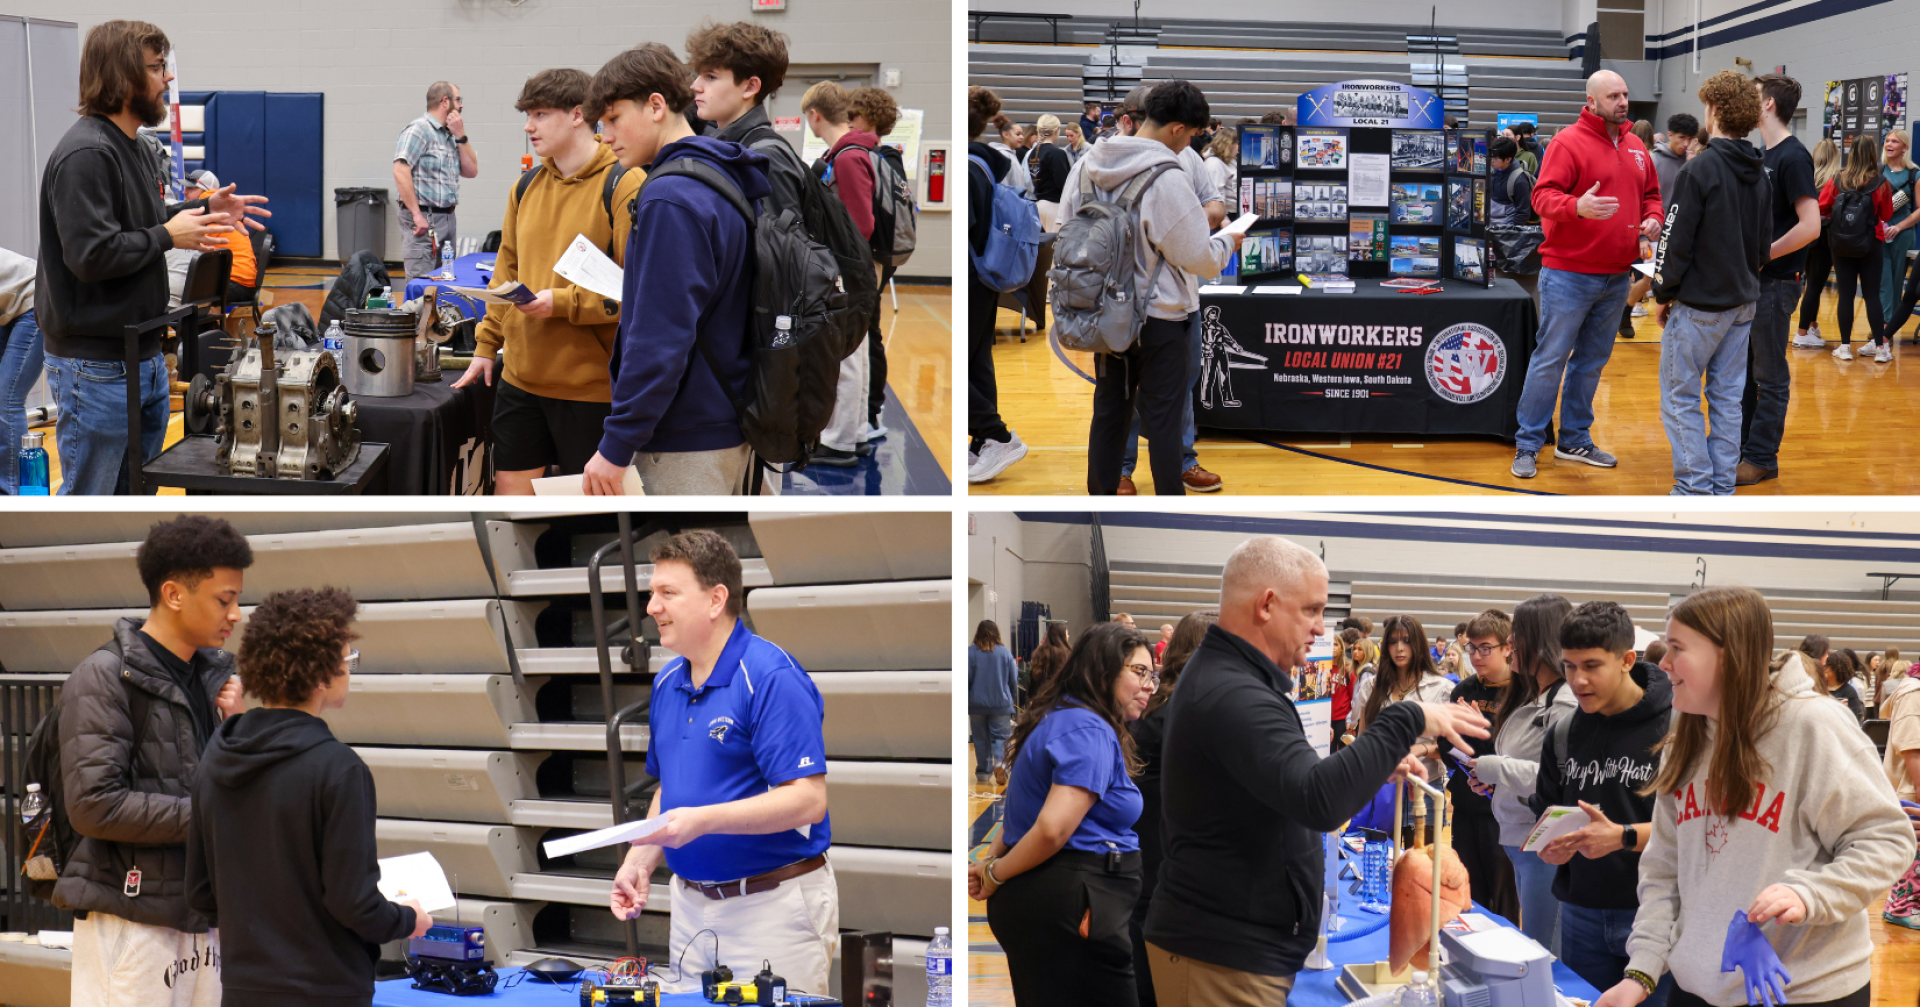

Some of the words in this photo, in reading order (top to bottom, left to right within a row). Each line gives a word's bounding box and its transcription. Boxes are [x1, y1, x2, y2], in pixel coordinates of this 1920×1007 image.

[1655, 203, 1679, 272] carhartt
[1264, 322, 1423, 347] IRONWORKERS
[1284, 351, 1327, 368] LOCAL
[1330, 352, 1376, 369] UNION
[1376, 353, 1402, 369] #21
[1273, 373, 1311, 384] Nebraska,
[1312, 373, 1342, 384] Western
[1342, 375, 1362, 385] Iowa,
[1363, 375, 1385, 384] South
[1386, 375, 1412, 385] Dakota
[1325, 389, 1350, 398] SINCE
[1351, 389, 1369, 399] 1901
[1618, 756, 1653, 788] Hart
[163, 948, 200, 989] God
